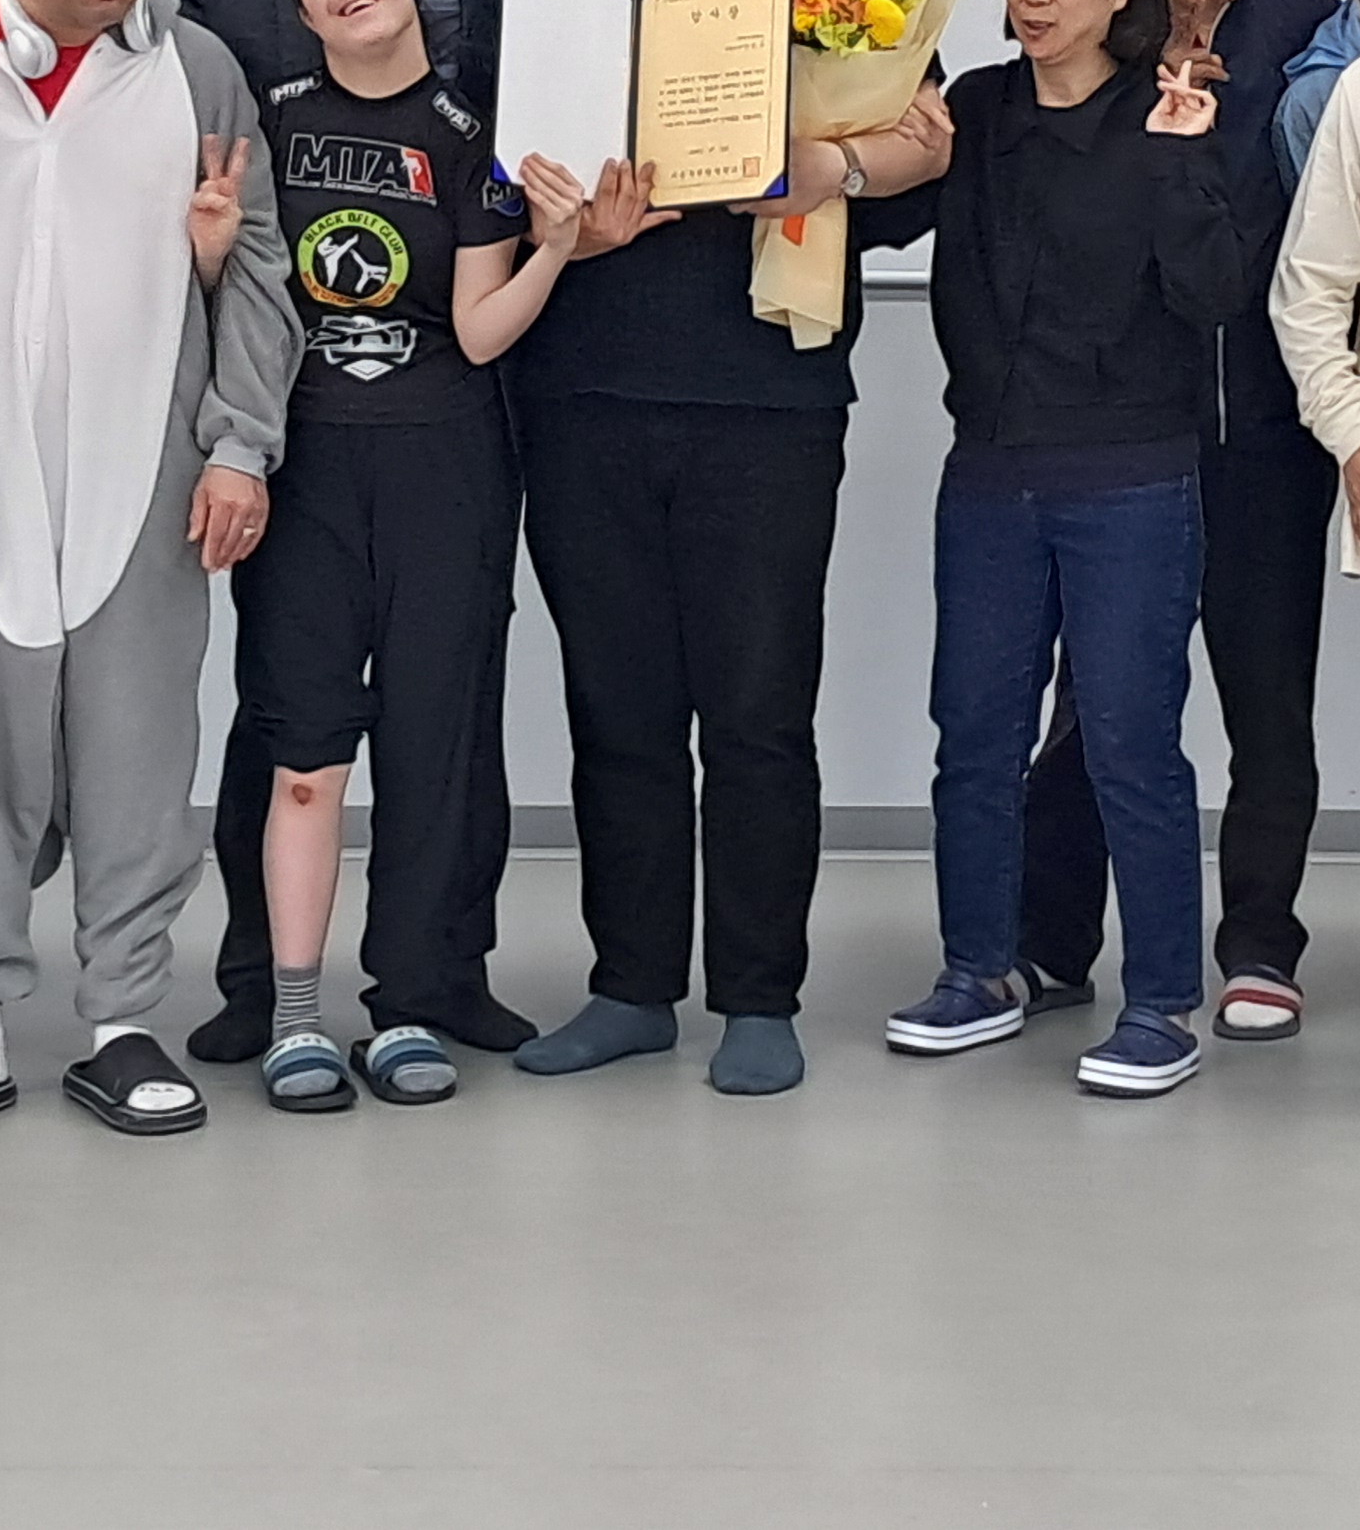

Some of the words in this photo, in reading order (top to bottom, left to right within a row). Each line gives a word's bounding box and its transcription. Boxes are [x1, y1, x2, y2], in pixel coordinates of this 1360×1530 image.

[287, 133, 415, 192] MTA
[304, 213, 344, 243] BLACK
[347, 212, 379, 228] BELT
[379, 225, 404, 256] CLUB
